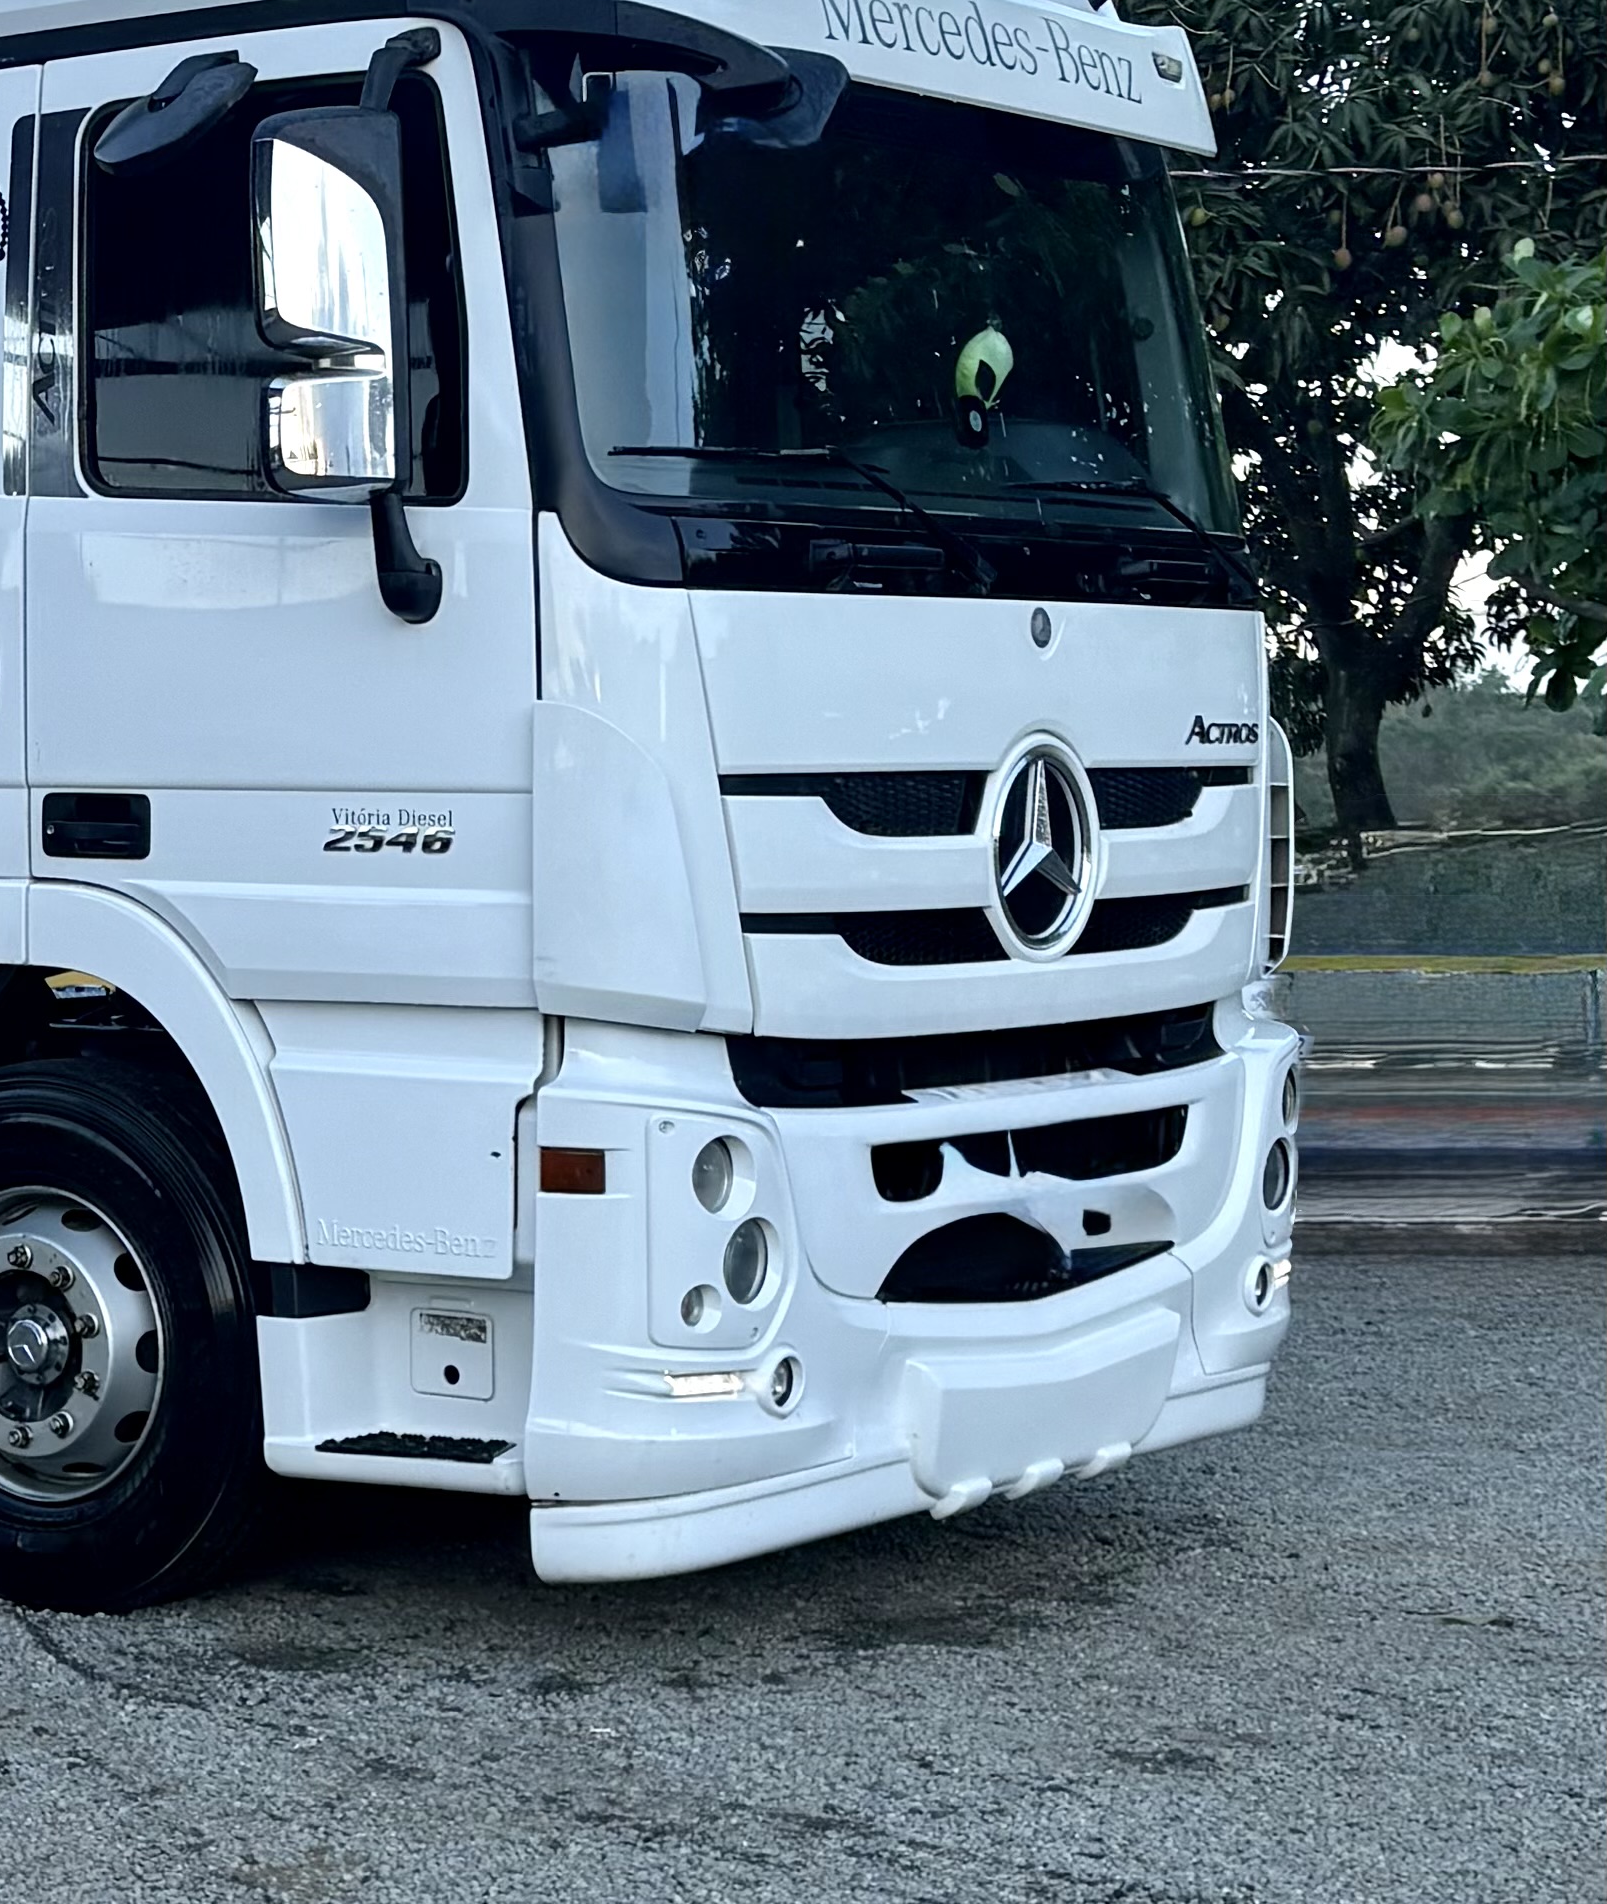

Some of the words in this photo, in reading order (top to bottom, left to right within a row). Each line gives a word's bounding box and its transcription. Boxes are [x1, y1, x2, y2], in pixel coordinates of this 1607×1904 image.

[331, 807, 391, 827] Vitória
[398, 808, 453, 827] Diesel
[323, 824, 456, 854] 2546
[317, 1217, 498, 1259] Mercedes-Benz
